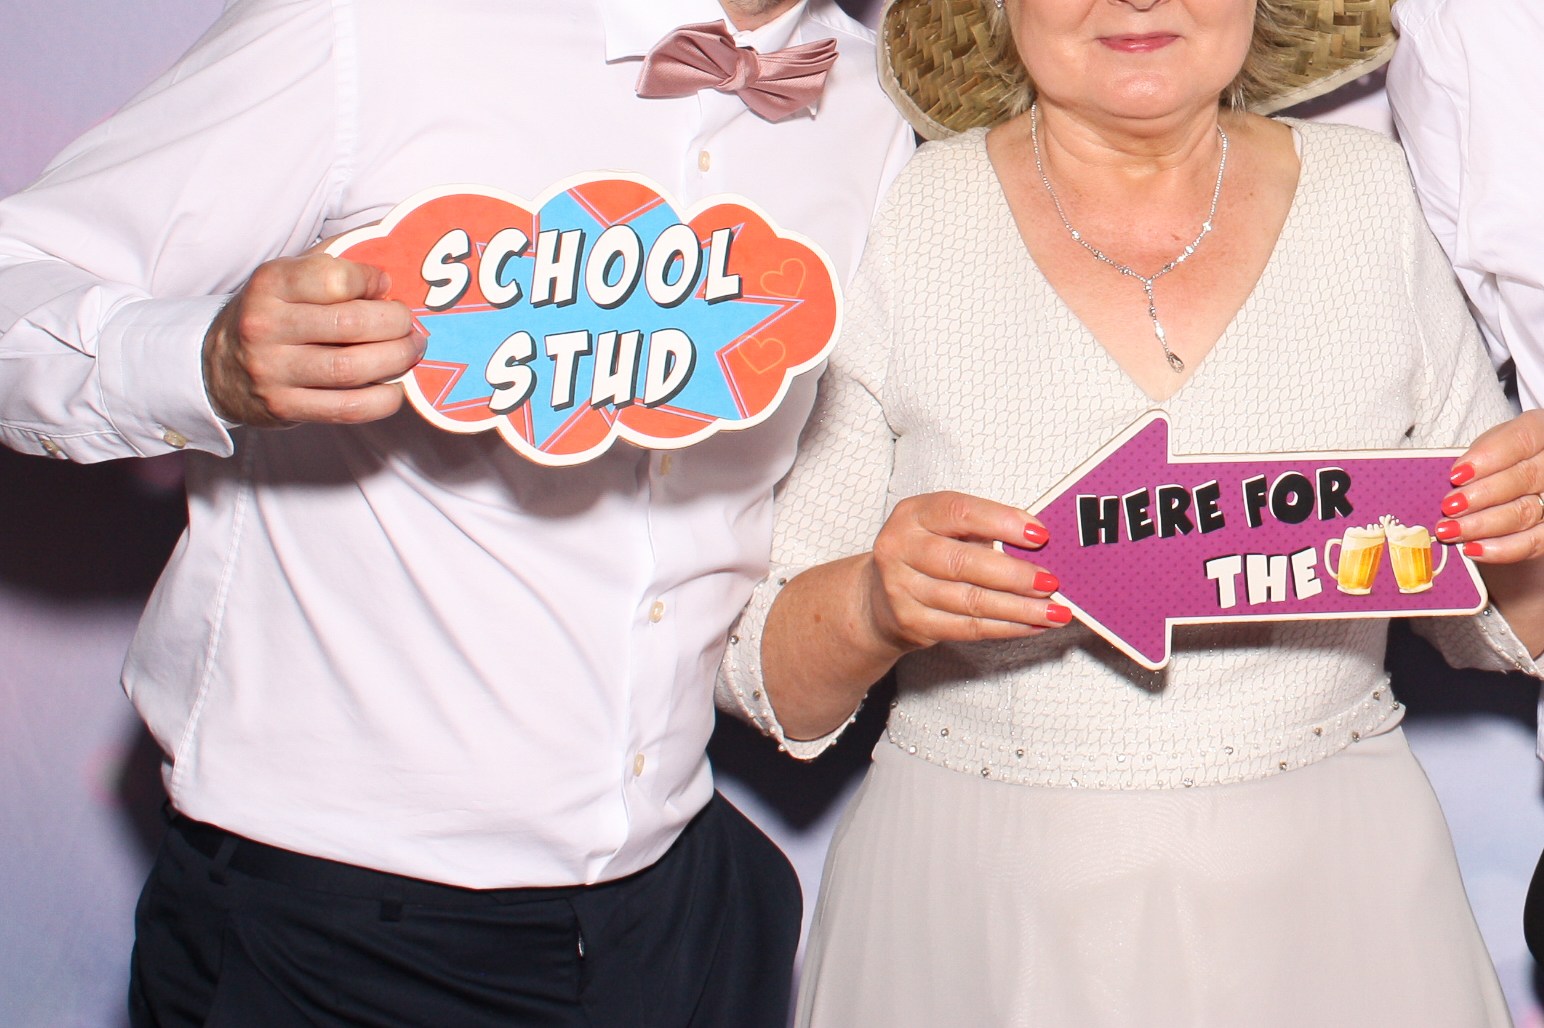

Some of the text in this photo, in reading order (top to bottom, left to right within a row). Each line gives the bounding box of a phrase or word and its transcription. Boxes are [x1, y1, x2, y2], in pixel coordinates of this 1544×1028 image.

[421, 223, 742, 310] SCHOOL
[484, 328, 697, 414] STUD
[1076, 467, 1353, 546] HERE FOR
[1204, 547, 1323, 608] THE
